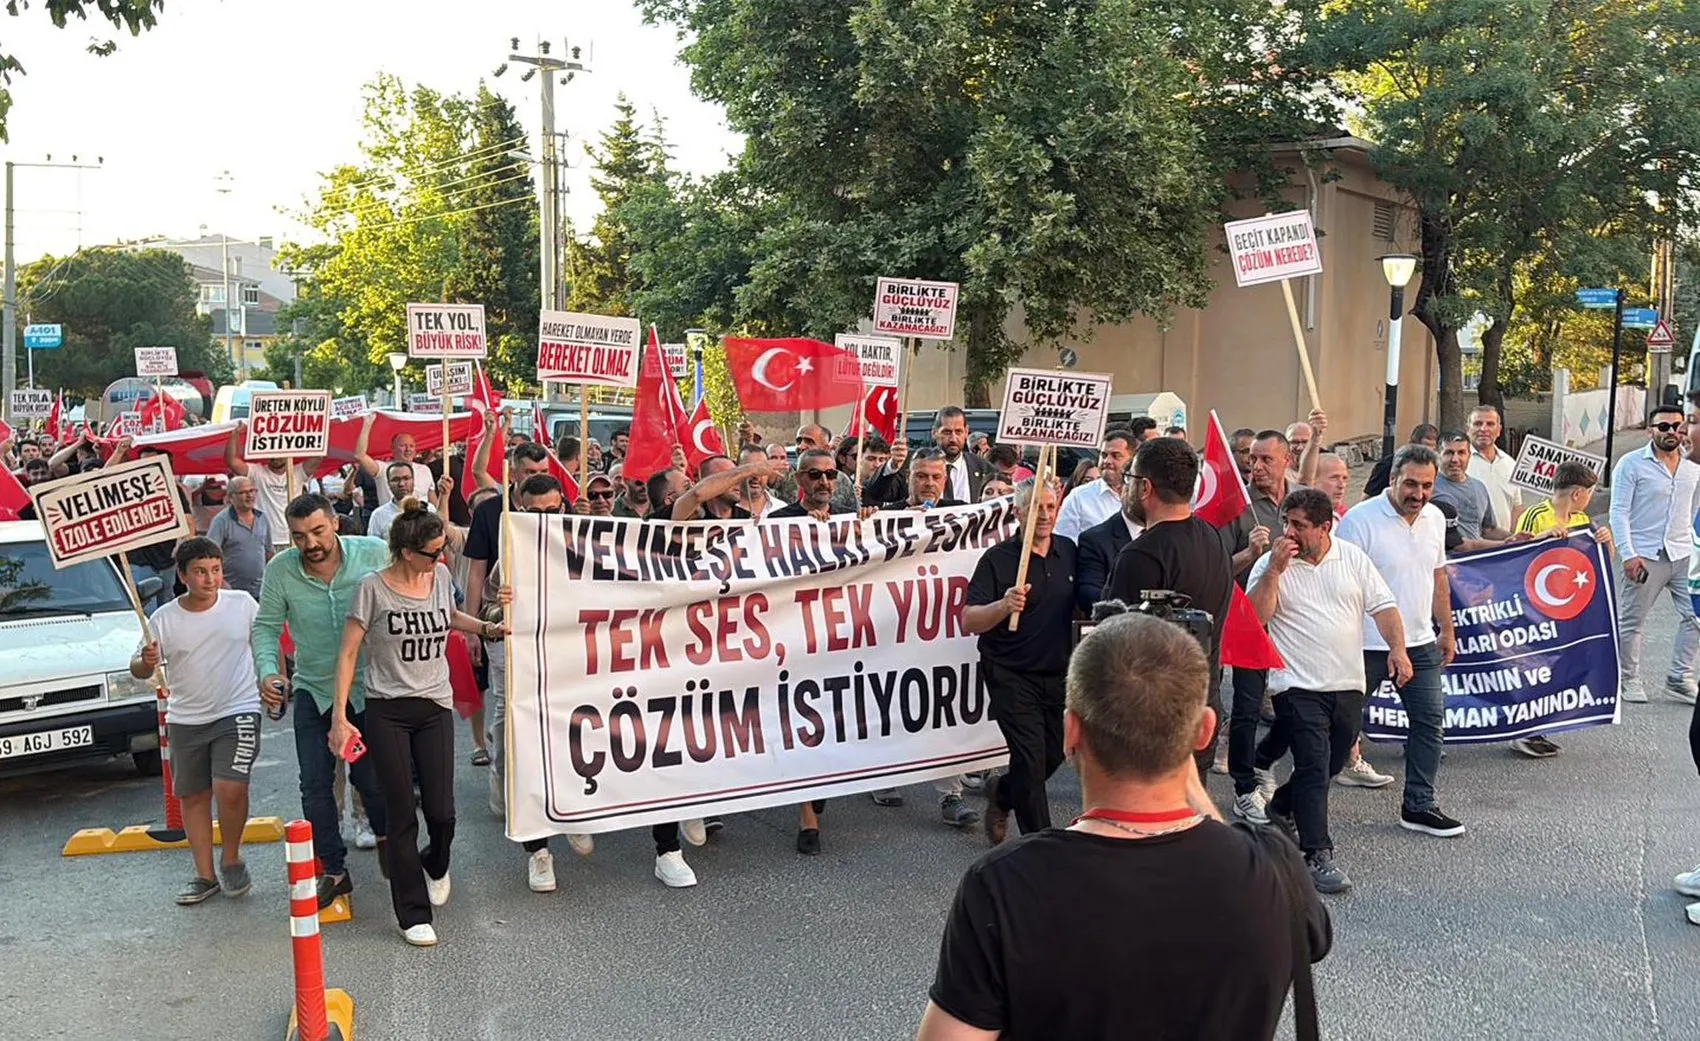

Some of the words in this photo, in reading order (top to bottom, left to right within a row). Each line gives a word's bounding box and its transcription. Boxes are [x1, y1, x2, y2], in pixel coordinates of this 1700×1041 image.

[1234, 228, 1264, 251] GEÇİT
[1266, 222, 1309, 245] KAPANDI
[1238, 248, 1273, 275] ÇÖZÜM
[1274, 243, 1314, 266] NEREDE?
[882, 294, 951, 309] GÜÇLÜYÜZ
[887, 284, 946, 298] BİRLİKTE
[415, 312, 444, 330] TEK
[447, 312, 479, 332] YOL,
[879, 321, 947, 333] KAZANACAĞIZ!
[891, 314, 937, 325] BİRLİKTE
[415, 331, 454, 350] BÜYÜK
[455, 332, 482, 350] RİSK!
[542, 322, 575, 338] HAREKET
[575, 325, 608, 342] OLMAYAN
[610, 328, 633, 344] YERDE
[539, 341, 592, 373] BEREKET
[592, 347, 632, 376] OLMAZ
[1020, 376, 1096, 395] BİRLİKTE
[255, 398, 291, 412] ÜRETEN
[293, 397, 325, 411] KÖYLÜ
[1012, 390, 1100, 410] GÜÇLÜYÜZ
[253, 412, 324, 436] ÇÖZÜM
[1006, 426, 1094, 442] KAZANACAĞIZ!
[1022, 416, 1081, 431] BİRLİKTE
[252, 434, 322, 450] İSTİYOR!
[58, 473, 156, 521] VELİMEŞE
[60, 521, 103, 551] İZOLE
[101, 500, 172, 537] EDİLEMEZ!
[872, 517, 920, 562] VE
[578, 606, 670, 675] TEK
[685, 592, 786, 667] SES,
[794, 583, 877, 654] TEK
[885, 564, 974, 644] YÜR
[1499, 620, 1558, 649] ODASI
[401, 635, 445, 662] OUT
[1440, 667, 1523, 696] ALKININ
[1524, 665, 1552, 686] ve
[1368, 705, 1410, 728] HER
[1442, 706, 1498, 729] MAN
[1502, 684, 1616, 725] YANINDA...
[568, 678, 766, 796] ÇÖZÜM
[777, 660, 988, 750] İSTİYORU
[0, 739, 12, 755] 9
[24, 733, 52, 752] AGJ
[61, 728, 91, 746] 592
[231, 715, 255, 774] ATHLETIC
